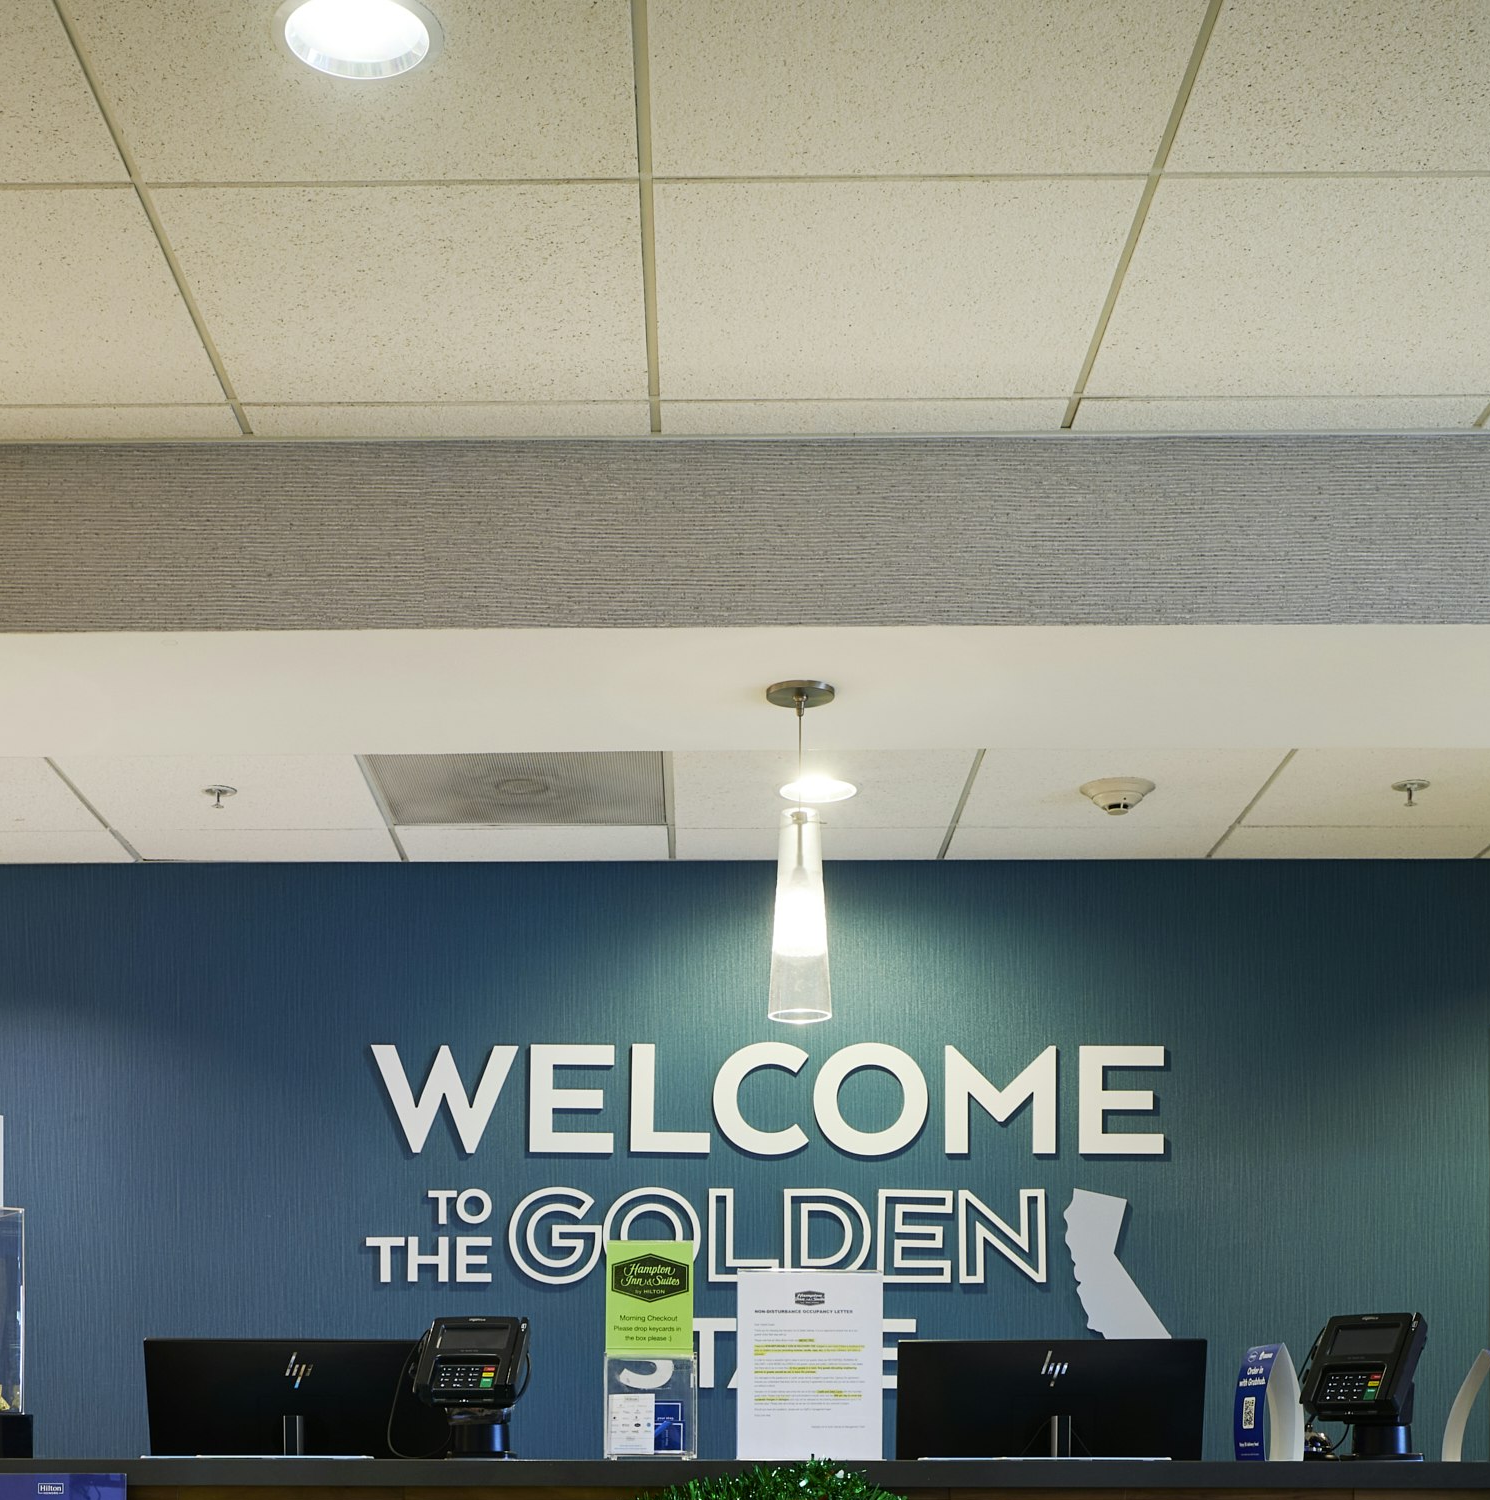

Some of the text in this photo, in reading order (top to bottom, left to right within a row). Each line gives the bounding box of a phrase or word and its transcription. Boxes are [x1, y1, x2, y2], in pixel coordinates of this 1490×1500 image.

[370, 1042, 1165, 1156] WELCOME
[428, 1188, 492, 1224] TO
[366, 1186, 1046, 1284] THE GOLDEN
[620, 1275, 646, 1287] Inn
[652, 1275, 680, 1286] Suites
[623, 1263, 676, 1277] Hampton
[619, 1315, 646, 1323] Morning
[285, 1352, 313, 1388] hp
[1041, 1350, 1068, 1387] hp
[1247, 1367, 1259, 1375] Order
